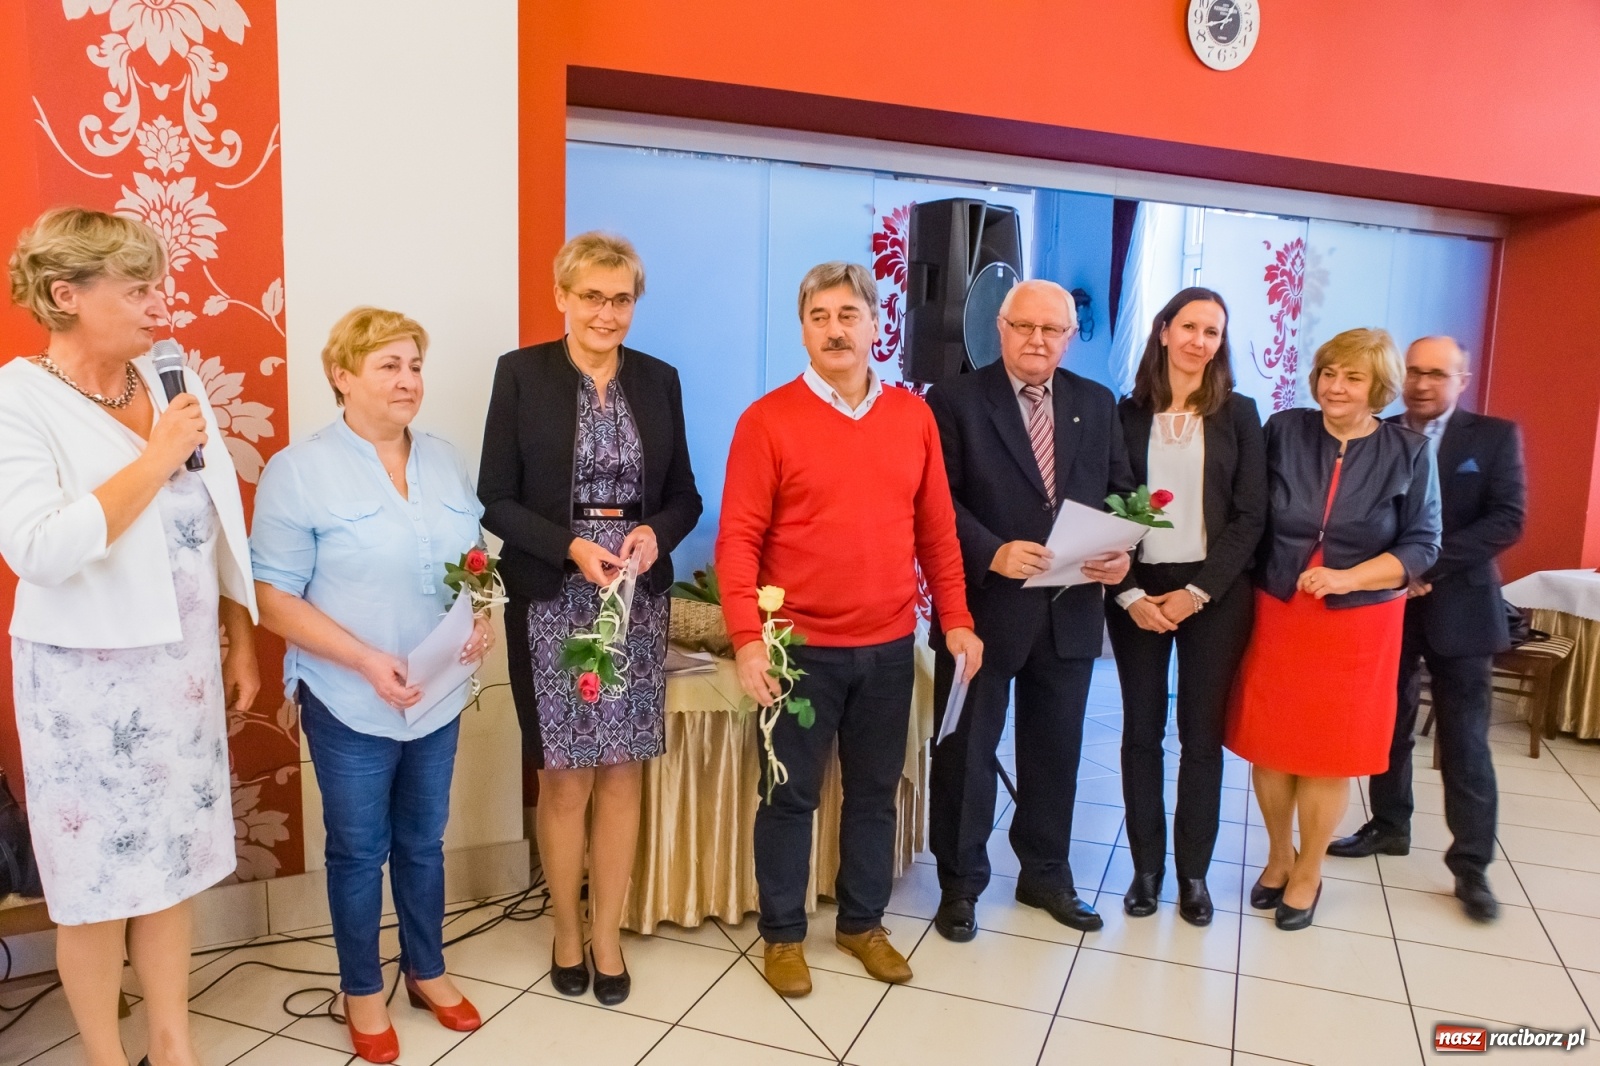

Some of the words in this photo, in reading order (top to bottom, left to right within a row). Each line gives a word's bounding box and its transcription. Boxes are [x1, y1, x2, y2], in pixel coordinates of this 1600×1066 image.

[1244, 2, 1252, 15] 2
[1194, 9, 1203, 24] 9
[1245, 20, 1253, 32] 3
[1196, 29, 1206, 43] 8
[1207, 45, 1214, 58] 7
[1217, 48, 1226, 62] 6
[1230, 46, 1238, 59] 5
